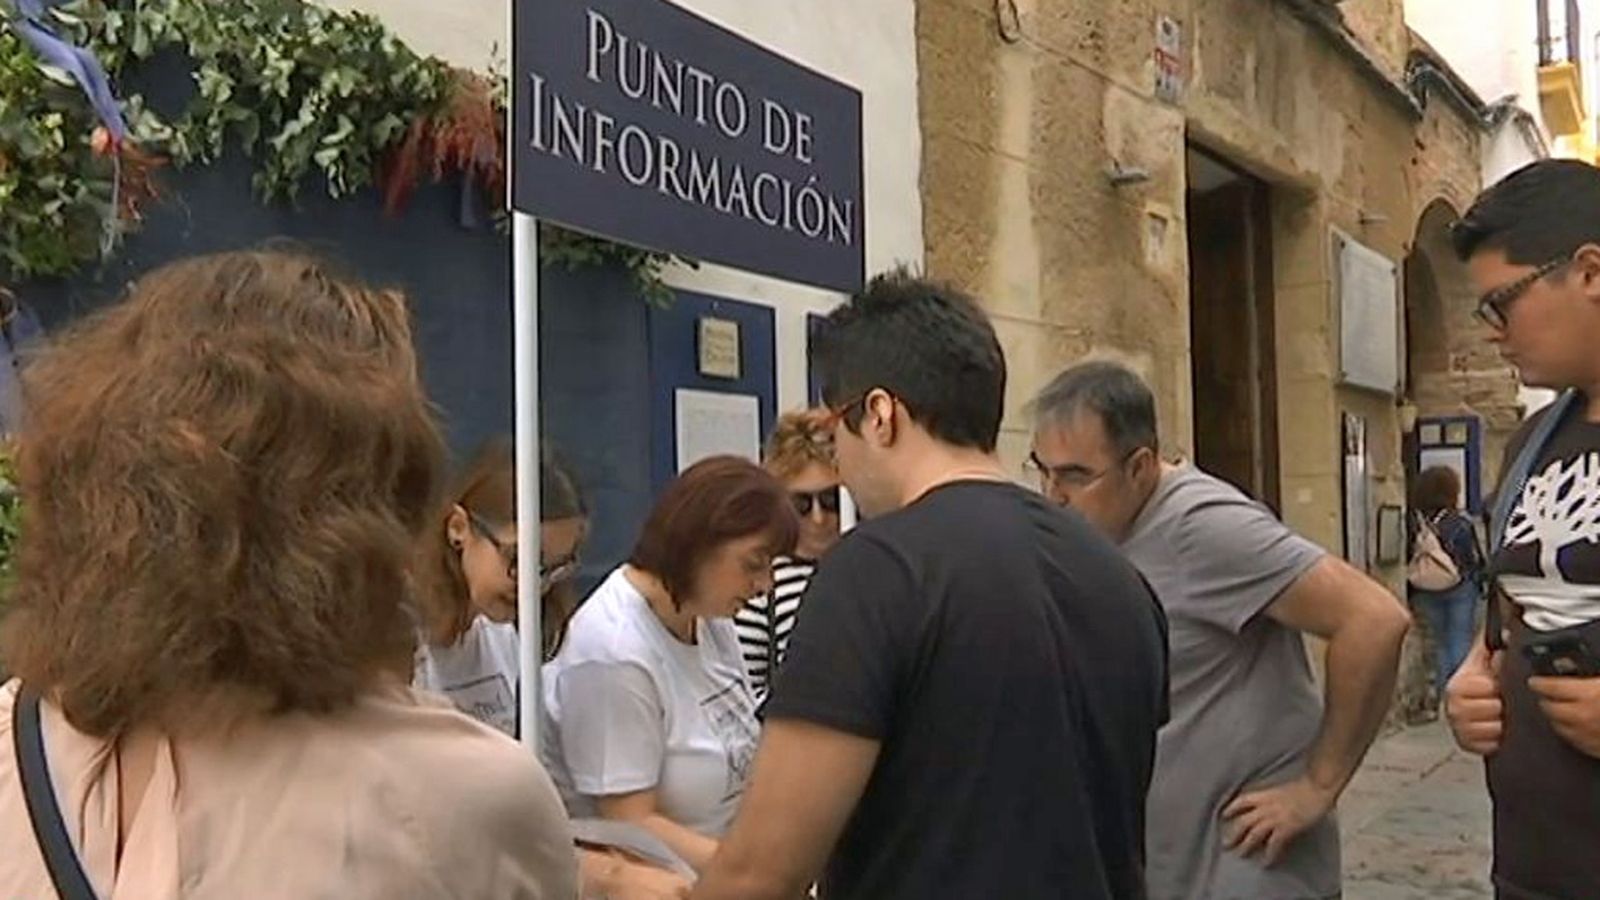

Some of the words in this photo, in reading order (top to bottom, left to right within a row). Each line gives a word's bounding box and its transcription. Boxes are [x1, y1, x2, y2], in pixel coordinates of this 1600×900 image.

[530, 73, 853, 245] INFORMACIÓN
[587, 10, 747, 138] PUNTO
[763, 99, 812, 164] DE
